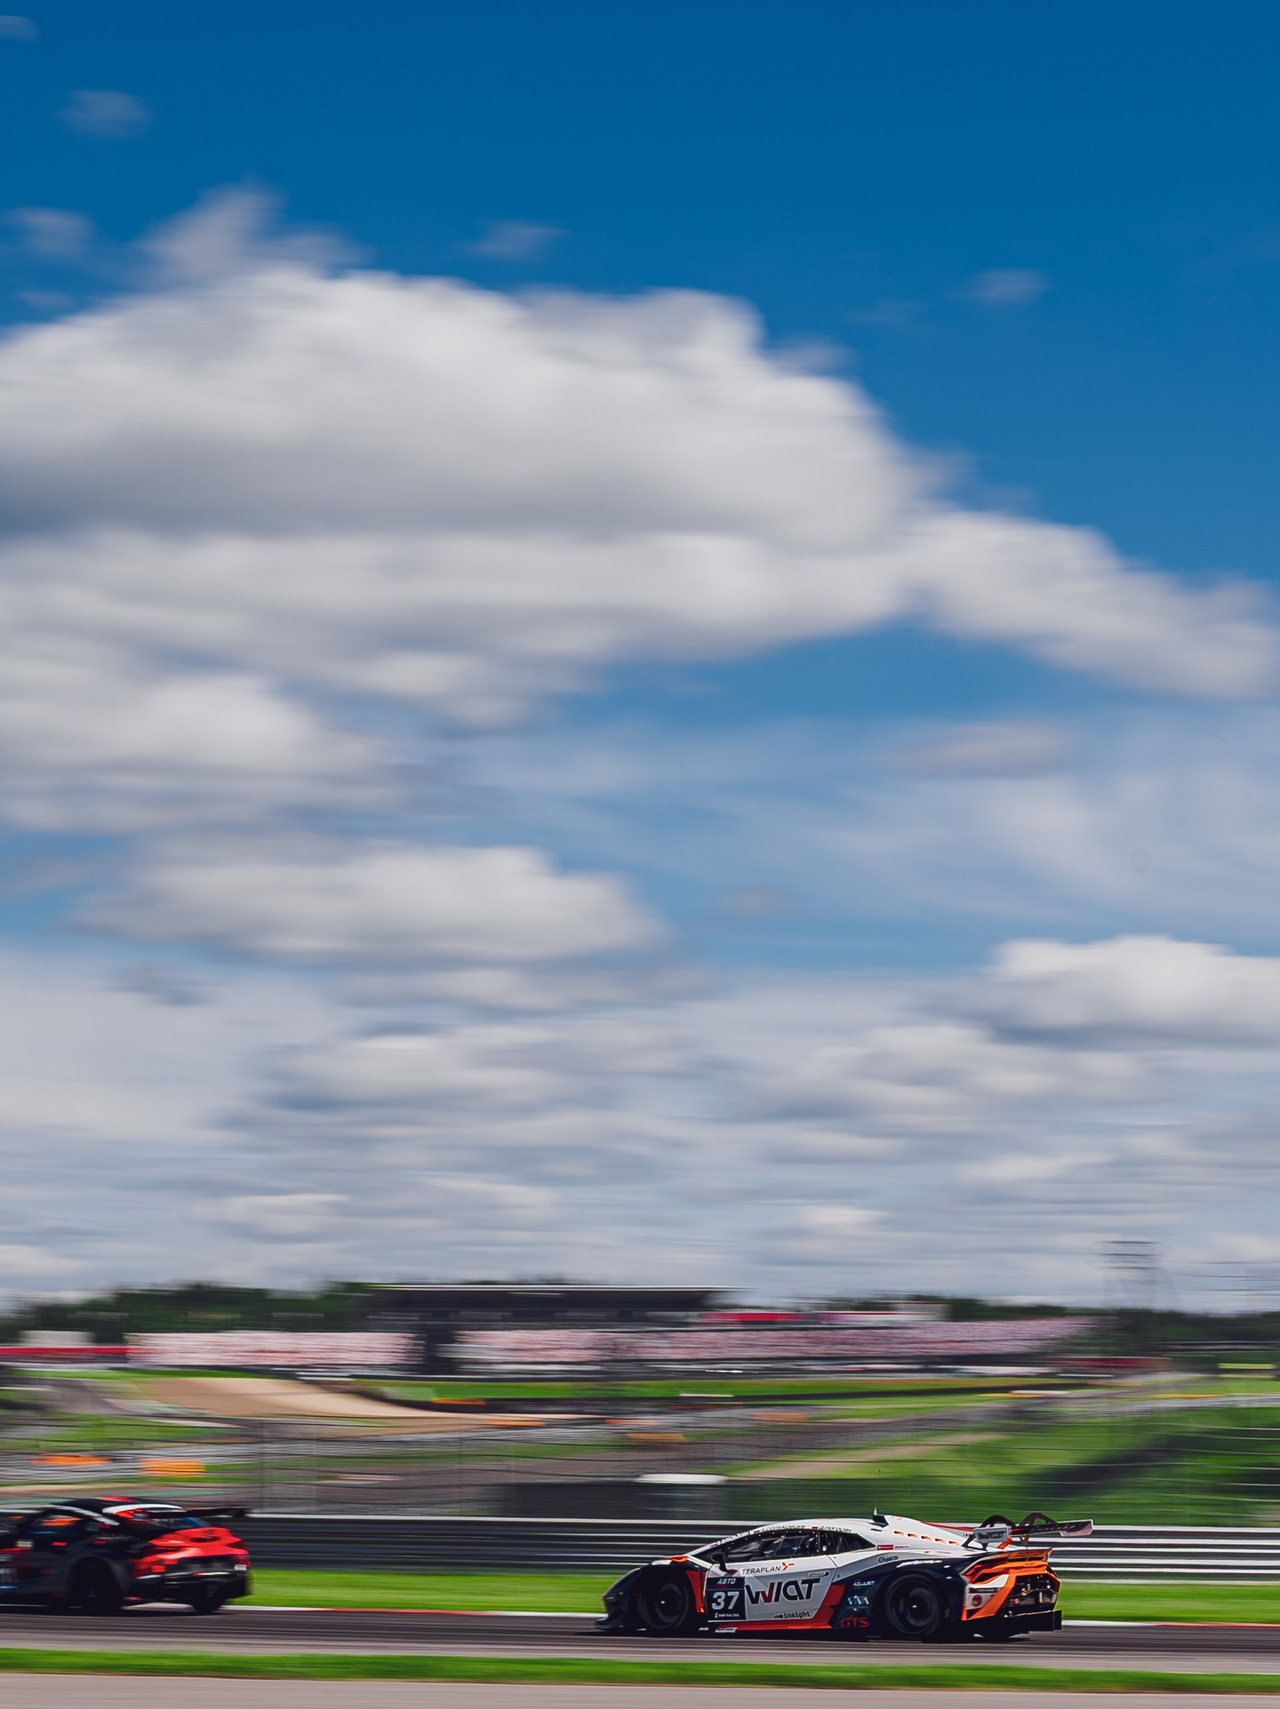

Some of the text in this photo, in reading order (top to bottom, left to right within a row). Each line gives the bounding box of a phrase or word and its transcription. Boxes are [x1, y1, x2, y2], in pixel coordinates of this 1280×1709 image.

[742, 1566, 781, 1575] TERAPLAN
[711, 1591, 740, 1610] 37
[783, 1611, 811, 1619] insight
[840, 1617, 870, 1628] GTS
